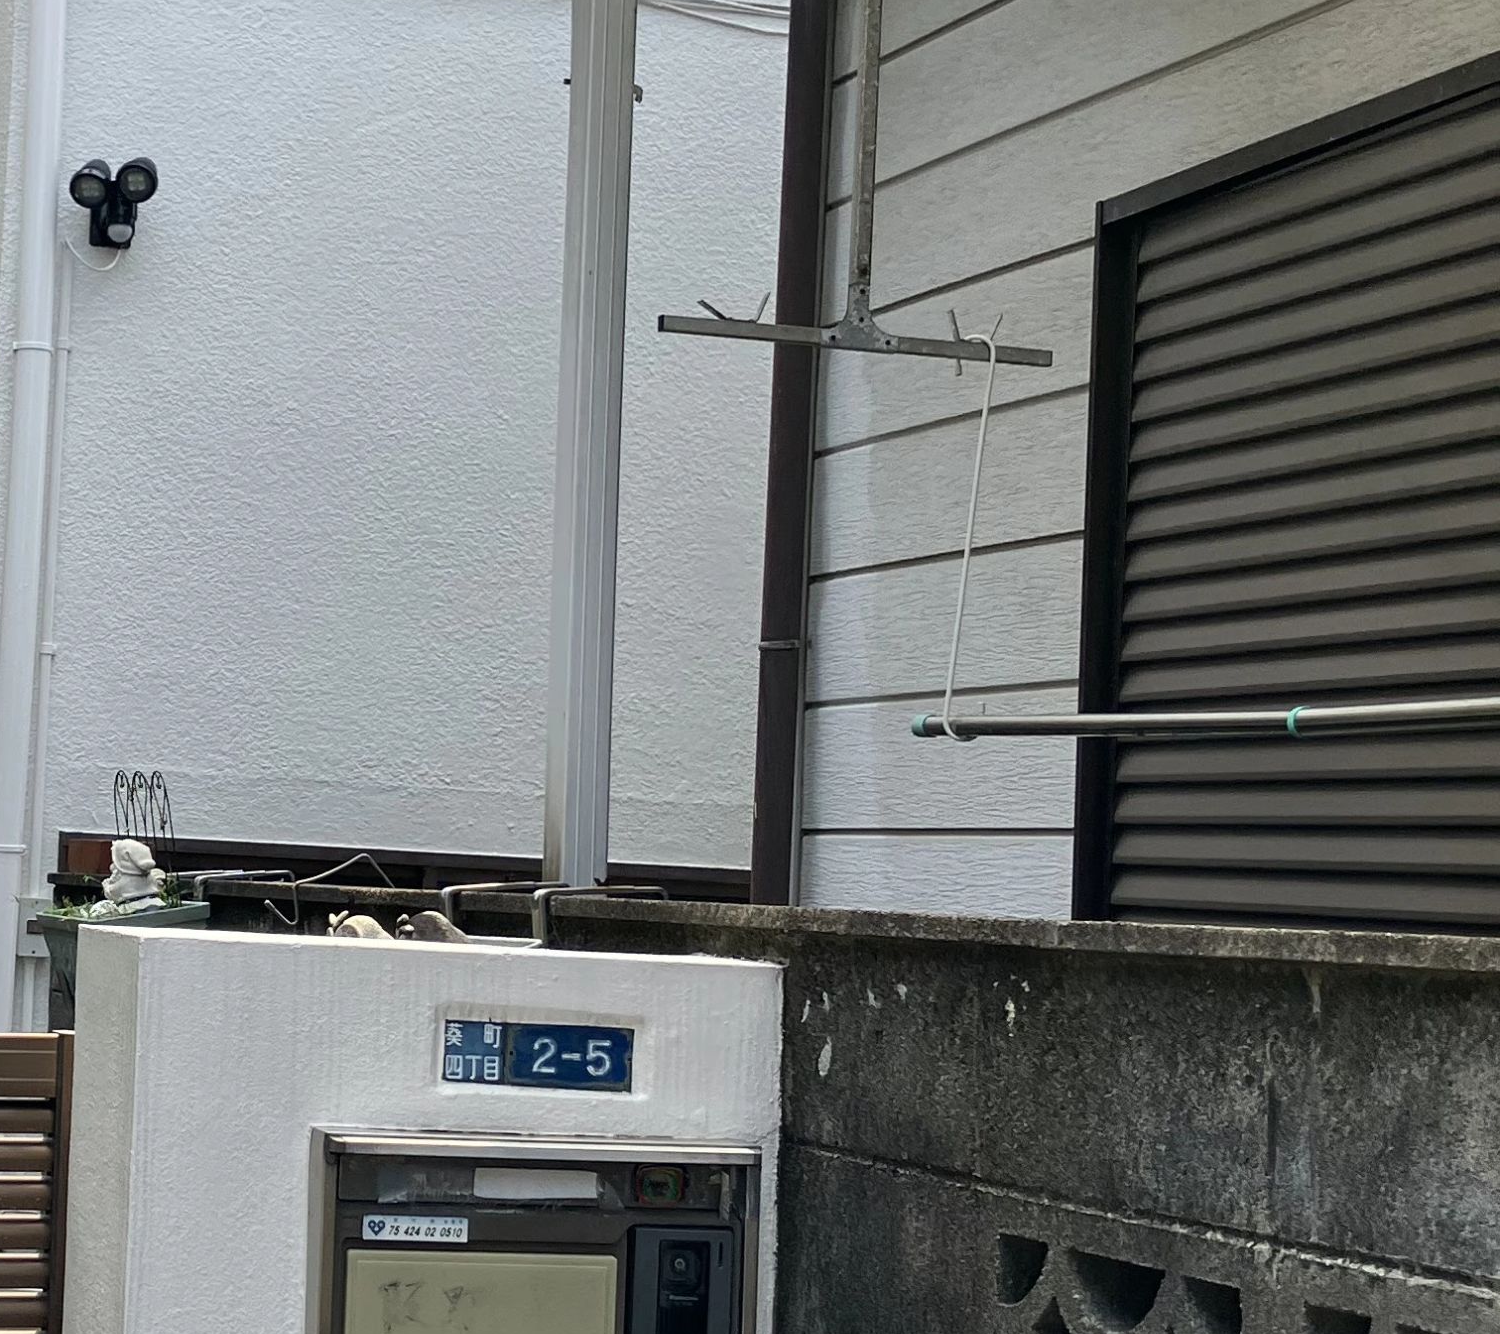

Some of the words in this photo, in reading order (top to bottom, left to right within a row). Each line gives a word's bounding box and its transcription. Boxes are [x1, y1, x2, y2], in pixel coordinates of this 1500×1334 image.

[445, 1054, 500, 1081] 四丁目
[531, 1037, 612, 1076] 2-5
[389, 1225, 400, 1236] 75
[404, 1226, 420, 1236] 424
[425, 1227, 436, 1237] 02
[440, 1227, 463, 1238] 0510
